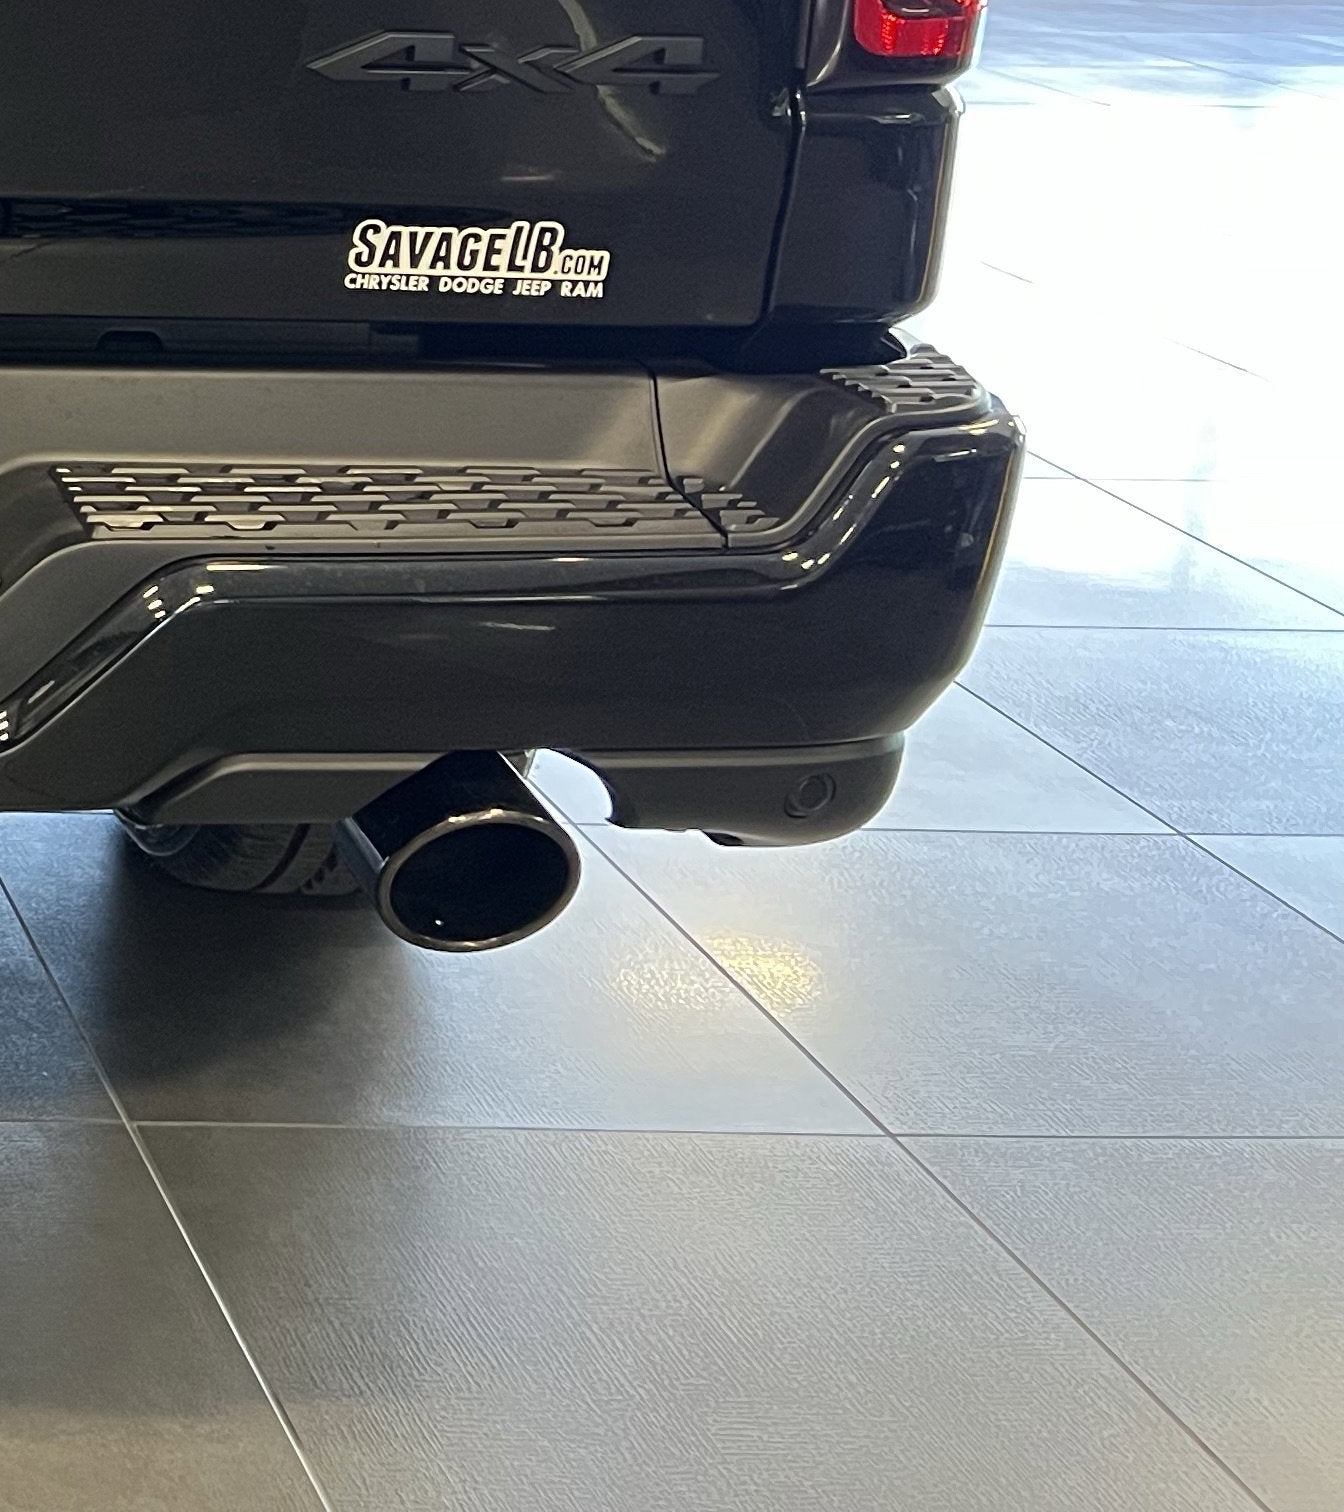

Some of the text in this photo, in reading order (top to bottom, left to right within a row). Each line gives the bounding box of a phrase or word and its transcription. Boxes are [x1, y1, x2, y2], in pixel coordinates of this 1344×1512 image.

[343, 273, 604, 298] CHRYSLER DODGE JEEP RAM
